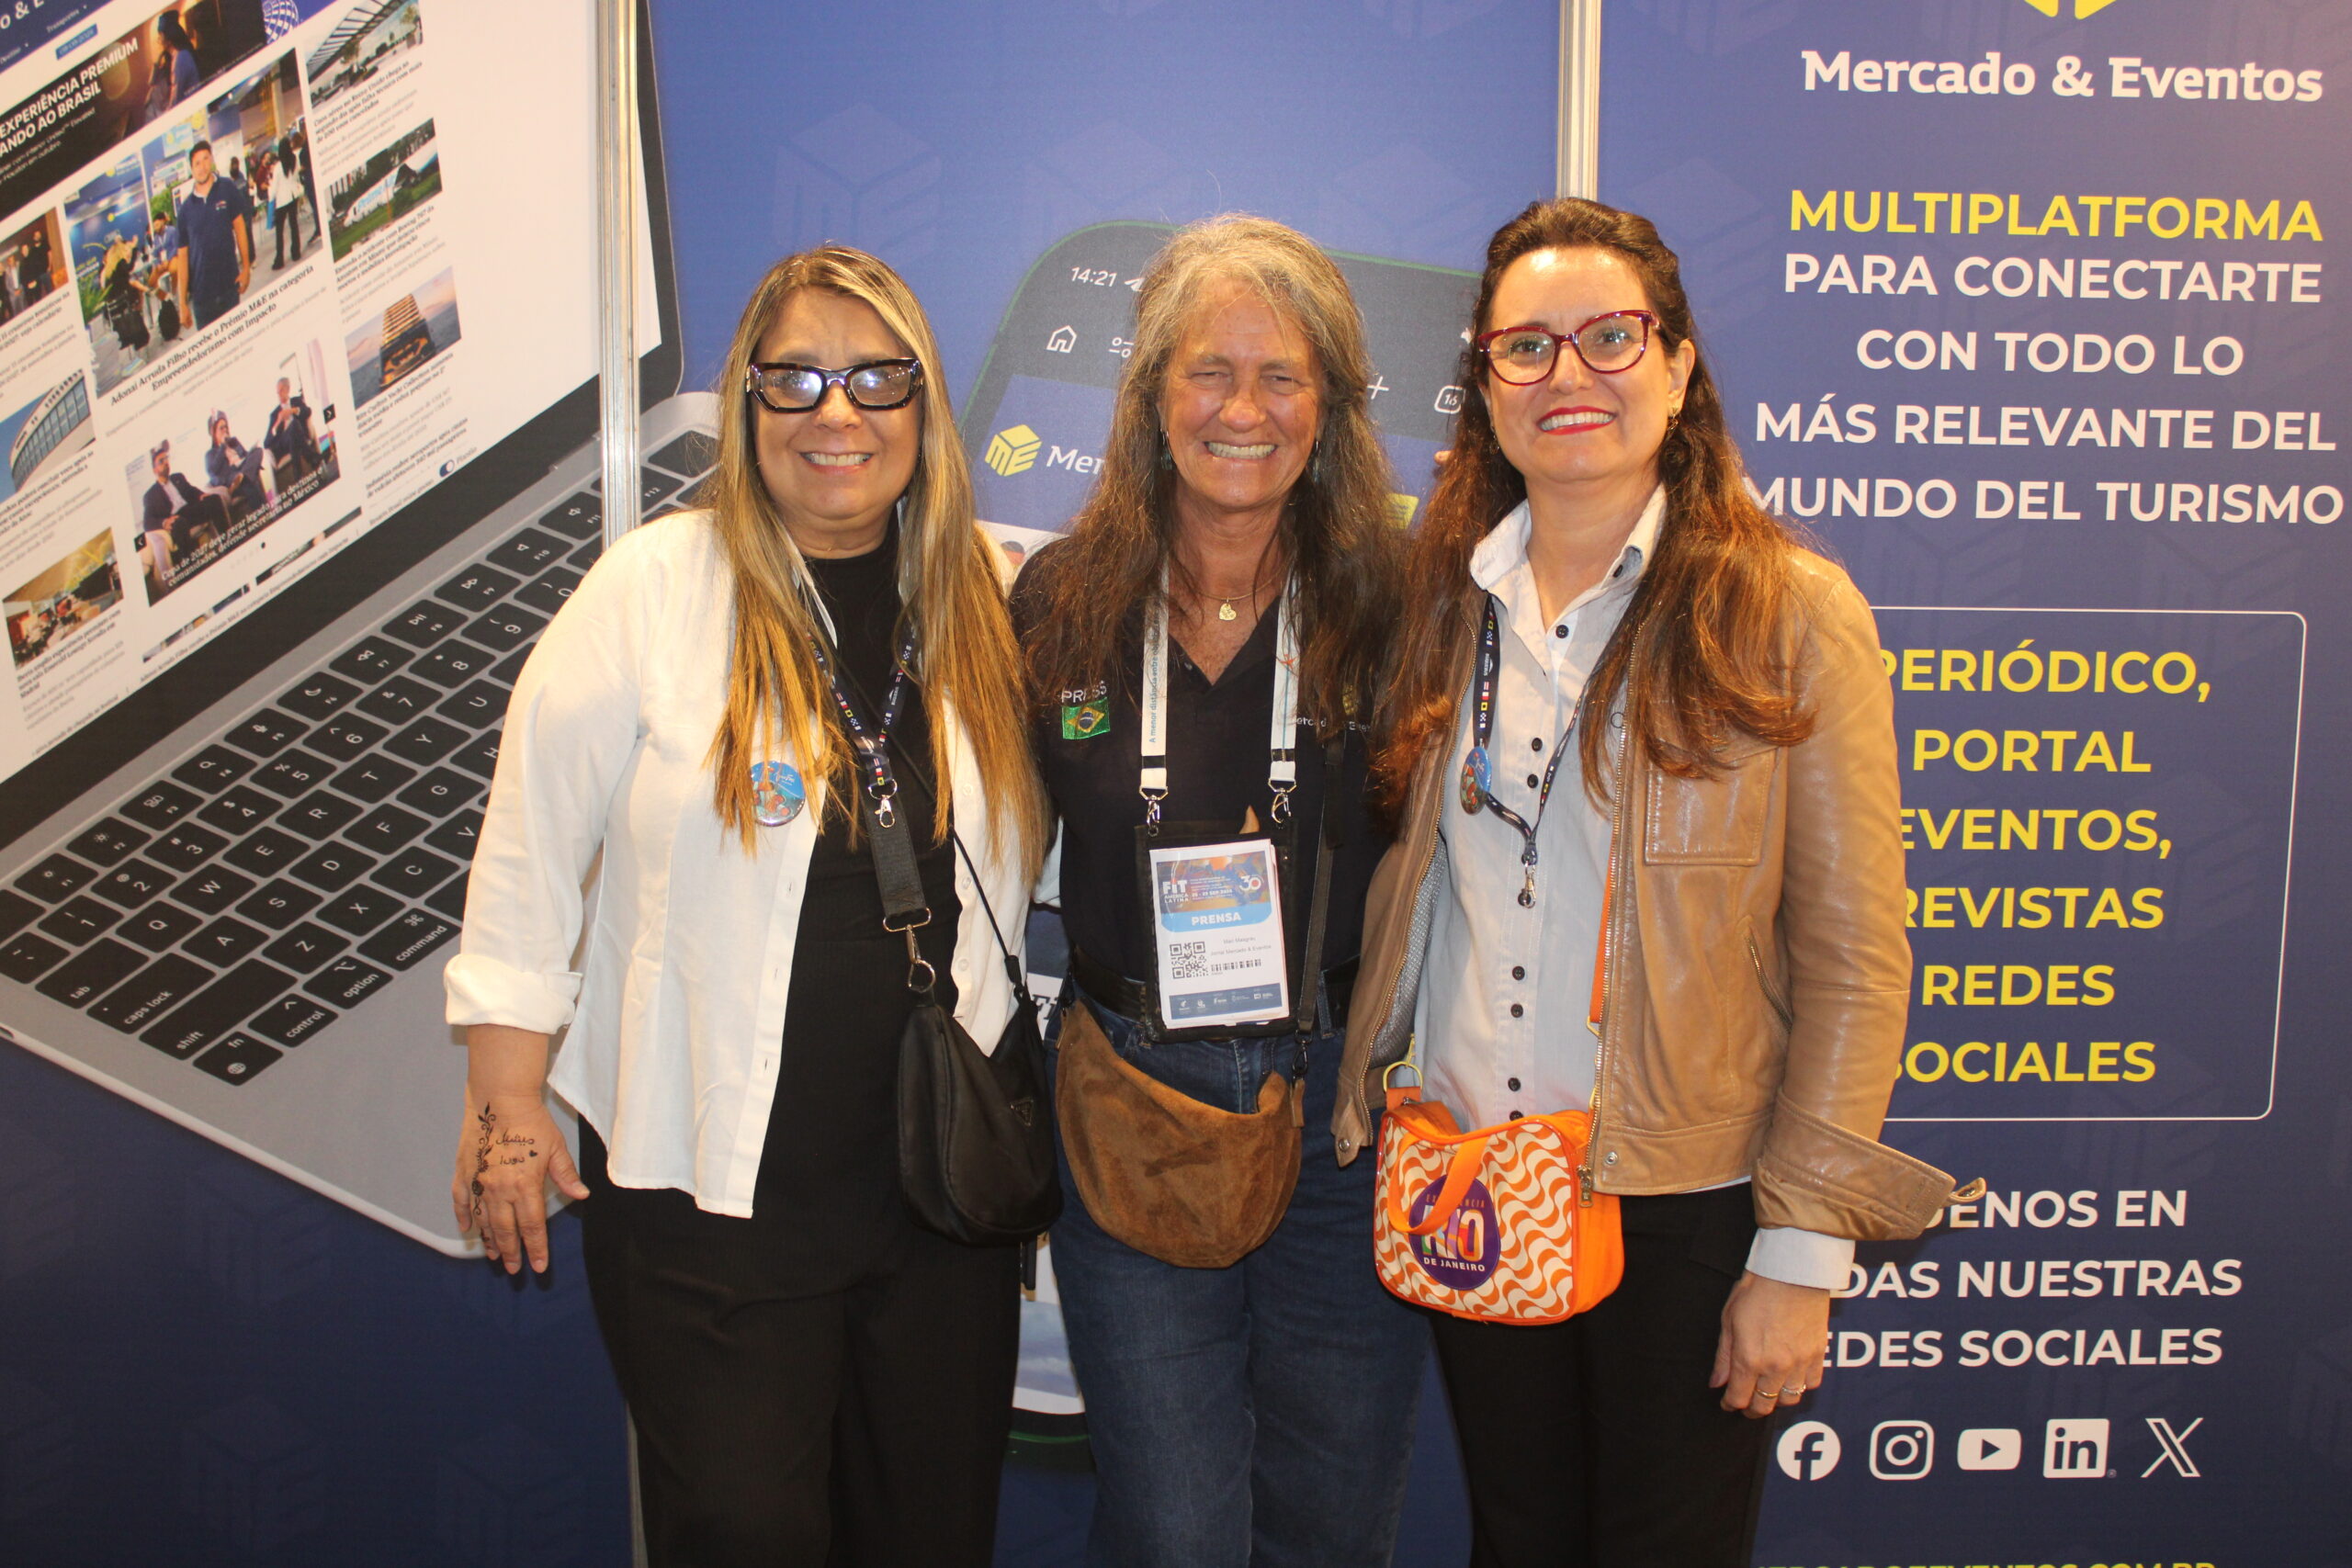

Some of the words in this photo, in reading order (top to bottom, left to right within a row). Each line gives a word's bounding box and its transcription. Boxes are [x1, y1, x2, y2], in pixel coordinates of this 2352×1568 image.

[79, 37, 138, 85] PREMIUM
[1802, 51, 2035, 95] Mercado
[2052, 55, 2095, 96] &
[2109, 57, 2324, 102] Eventos
[38, 109, 56, 131] AO
[57, 81, 101, 118] BRASIL
[1792, 190, 2323, 241] MULTIPLATFORMA
[1071, 266, 1117, 287] 14:21
[1785, 254, 1938, 295] PARA
[1954, 256, 2322, 302] CONECTARTE
[228, 325, 244, 339] com
[245, 302, 277, 329] Impacto
[110, 381, 138, 406] Adonai
[139, 363, 165, 387] Arruda
[166, 348, 187, 368] Filho
[187, 332, 212, 353] recebe
[278, 264, 313, 293] categoria
[1857, 330, 1977, 370] CON
[1995, 333, 2155, 374] TODO
[2174, 335, 2244, 376] LO
[1757, 393, 1876, 443] MÁS
[1895, 405, 2213, 448] RELEVANTE
[2233, 411, 2335, 450] DEL
[1742, 477, 1956, 518] MUNDO
[1976, 480, 2081, 520] DEL
[2097, 482, 2343, 524] TURISMO
[1061, 680, 1107, 704] PRSS
[469, 696, 488, 707] U
[415, 733, 432, 744] Y
[1914, 729, 2151, 772] PORTAL
[292, 771, 310, 781] 5
[361, 771, 379, 781] T
[431, 785, 448, 795] G
[242, 807, 256, 818] 4
[309, 808, 329, 818] R
[376, 821, 390, 833] F
[457, 827, 476, 838] V
[186, 844, 203, 854] 3
[254, 845, 275, 856] E
[322, 860, 340, 871] D
[404, 865, 423, 875] C
[133, 881, 151, 892] 2
[198, 880, 221, 894] W
[268, 897, 287, 908] S
[349, 902, 369, 914] X
[81, 919, 96, 927] 1
[148, 919, 168, 931] Q
[1191, 912, 1242, 926] PRENSA
[217, 935, 234, 947] A
[295, 940, 315, 953] Z
[395, 925, 448, 962] command
[343, 973, 379, 998] option
[1923, 965, 2114, 1005] REDES
[70, 986, 90, 999] tab
[123, 1006, 150, 1025] caps
[145, 990, 174, 1008] lock
[286, 1010, 325, 1038] control
[176, 1031, 205, 1050] shift
[227, 1038, 244, 1049] fn
[1894, 1042, 2155, 1082] OCIALES
[1926, 1190, 2098, 1228] ENOS
[2117, 1190, 2186, 1226] EN
[1423, 1257, 1437, 1266] DE
[1441, 1259, 1486, 1271] JANEIRO
[1959, 1259, 2241, 1297] NUESTRAS
[1960, 1328, 2222, 1366] SOCIALES
